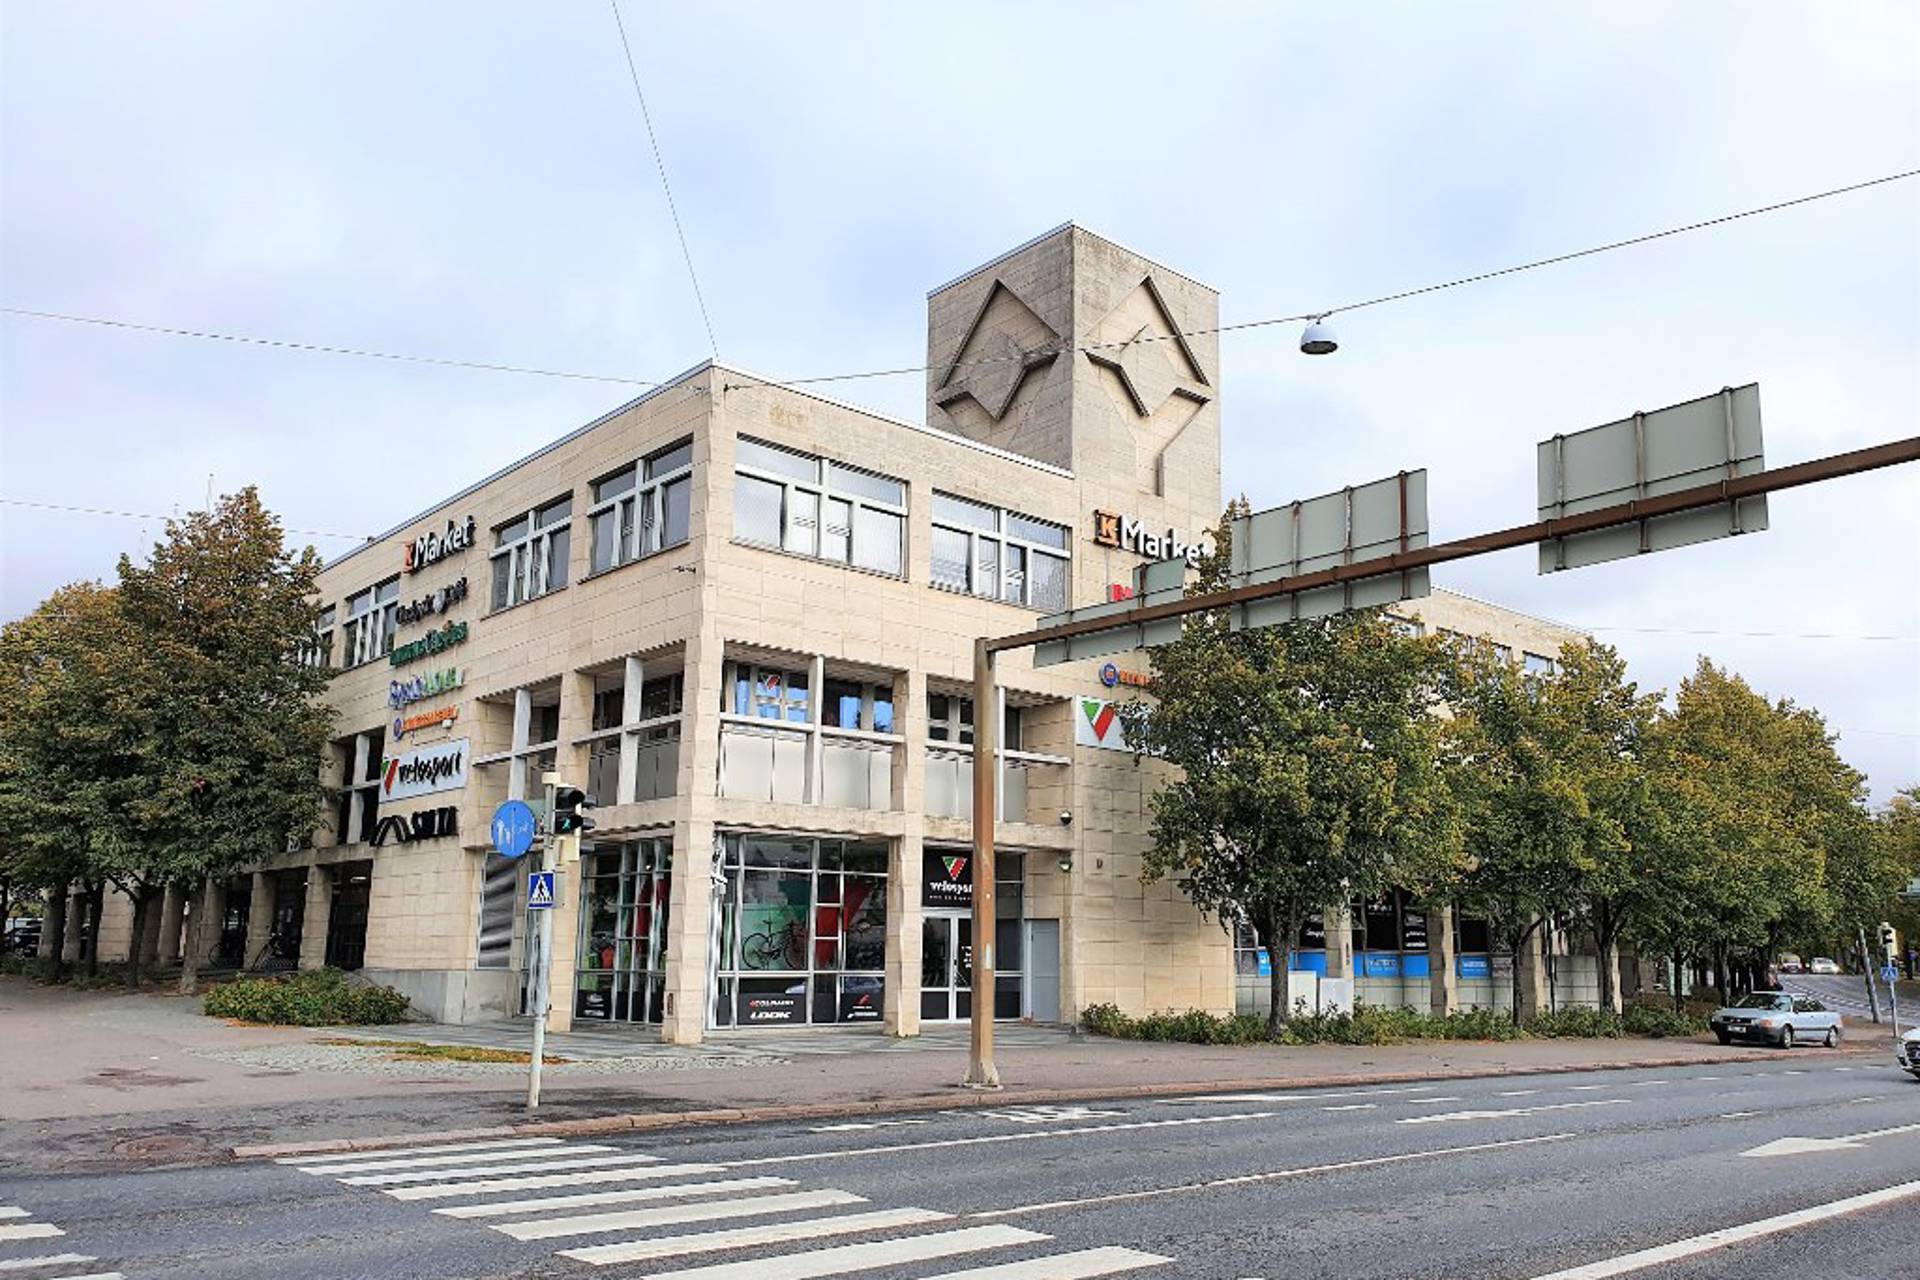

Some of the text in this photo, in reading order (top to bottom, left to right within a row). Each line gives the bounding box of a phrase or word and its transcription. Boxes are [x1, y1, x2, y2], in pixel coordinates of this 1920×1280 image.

[413, 515, 473, 569] Market
[399, 751, 462, 785] velosport
[750, 1011, 792, 1019] LOOK
